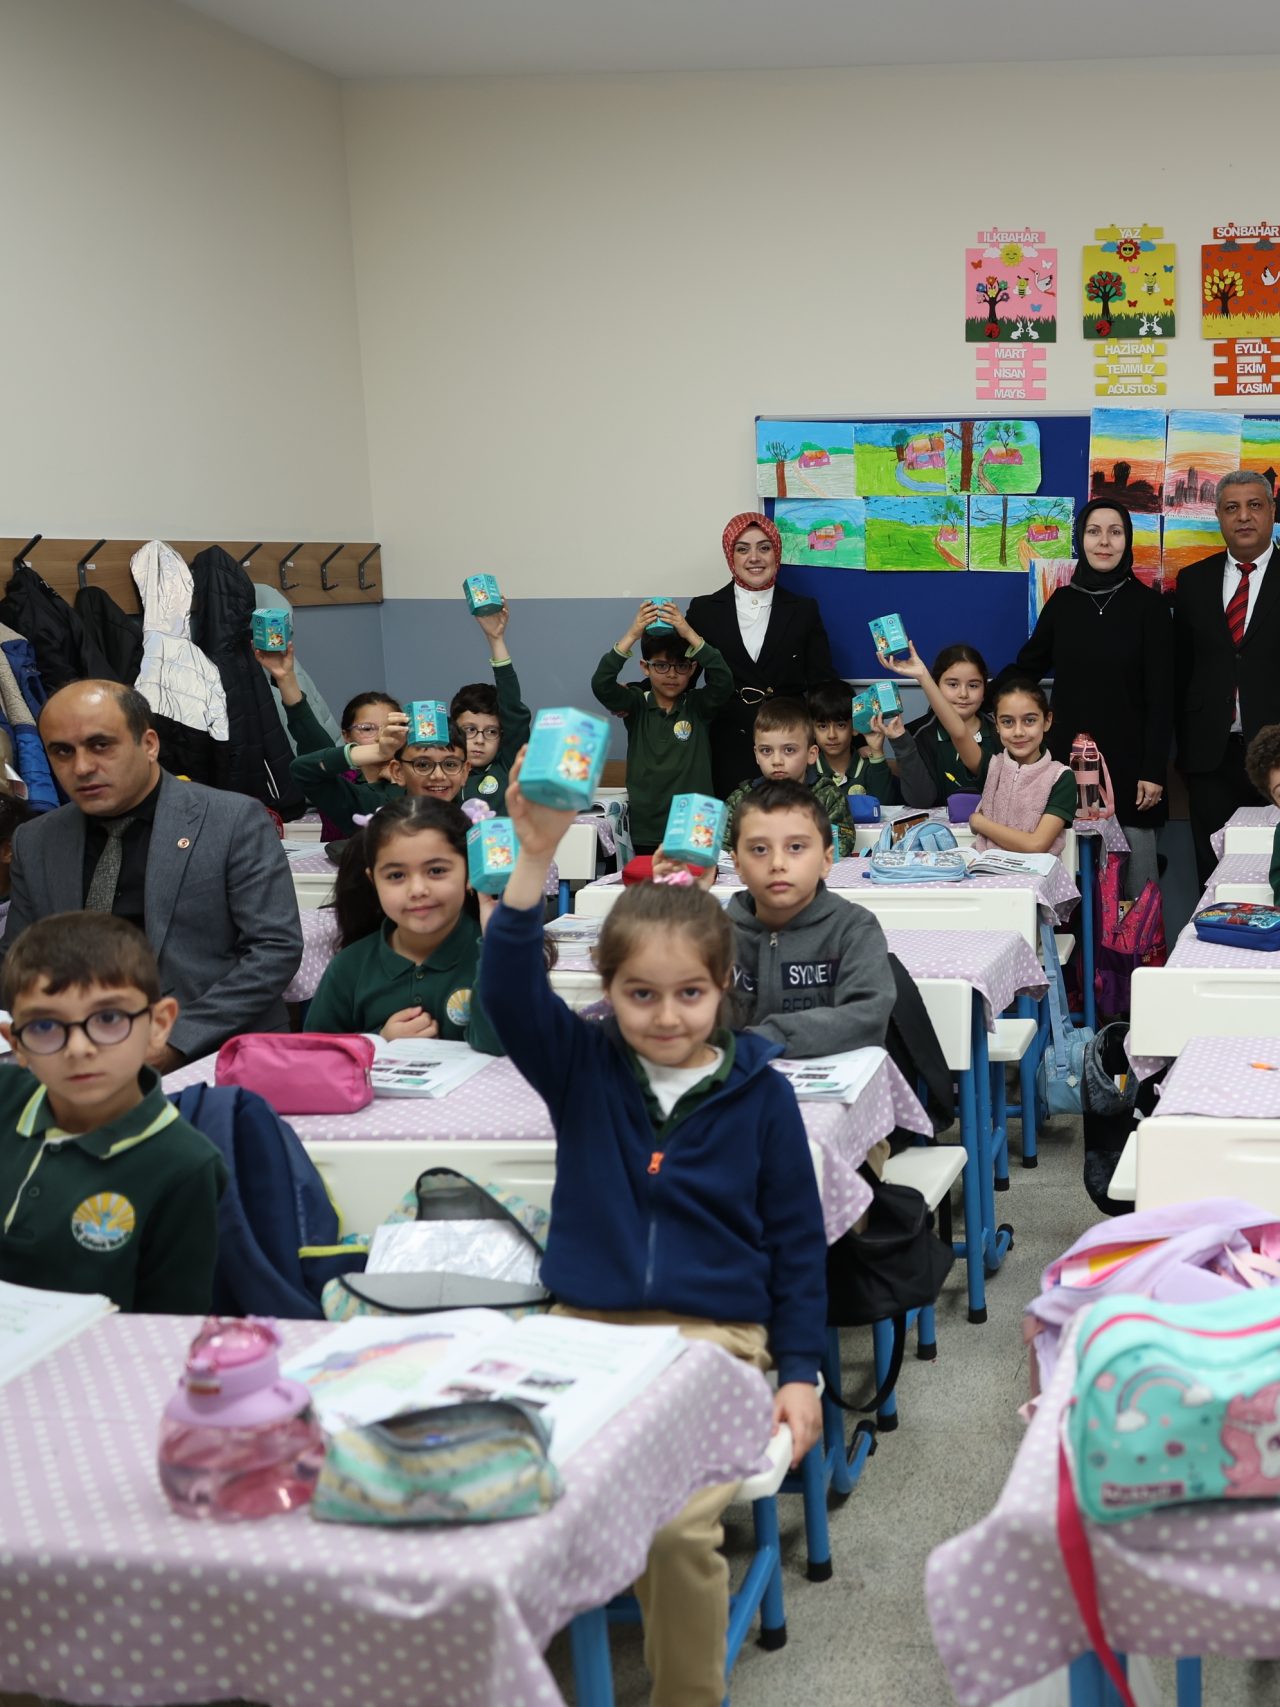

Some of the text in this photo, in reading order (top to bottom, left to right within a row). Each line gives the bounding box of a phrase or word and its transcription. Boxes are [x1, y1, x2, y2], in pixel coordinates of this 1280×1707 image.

[984, 230, 1039, 243] İLKBAHAR
[1119, 228, 1141, 239] YAZ
[1216, 225, 1280, 238] SONBAHAR
[994, 348, 1027, 359] MART
[1104, 343, 1155, 355] HAZİRAN
[1235, 341, 1271, 354] EYLÜL
[993, 367, 1026, 379] NİSAN
[1106, 363, 1155, 374] TEMMUZ
[1236, 362, 1266, 374] EKİM
[994, 388, 1026, 399] MAYIS
[1236, 382, 1273, 394] KASIM
